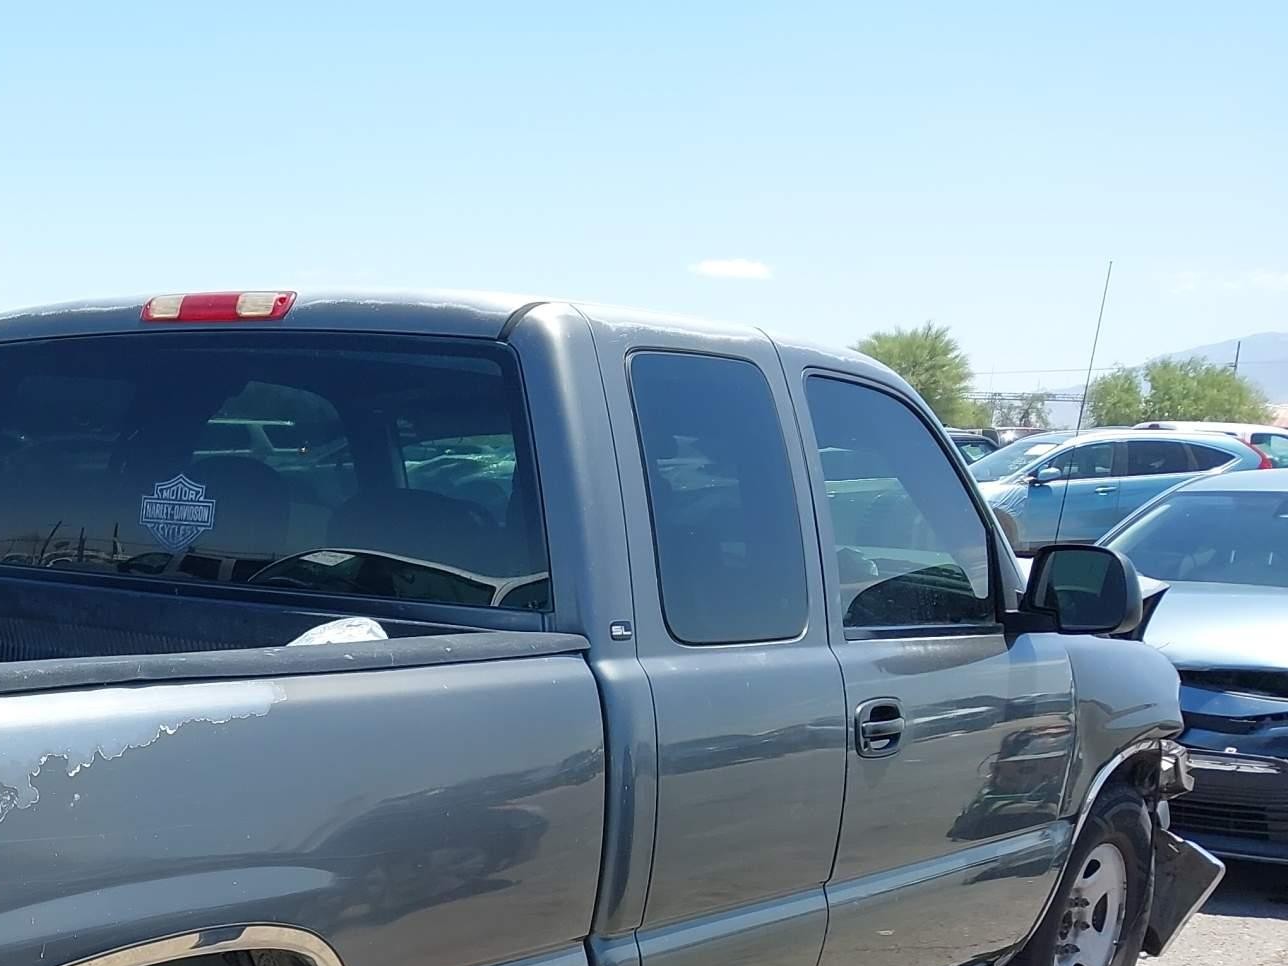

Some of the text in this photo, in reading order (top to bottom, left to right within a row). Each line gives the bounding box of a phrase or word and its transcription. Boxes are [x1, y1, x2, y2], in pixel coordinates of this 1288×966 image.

[162, 484, 197, 501] MOTOR
[145, 503, 210, 522] HARLEY-DAVIDSON
[158, 524, 191, 539] CYCLES
[611, 625, 632, 636] SL
